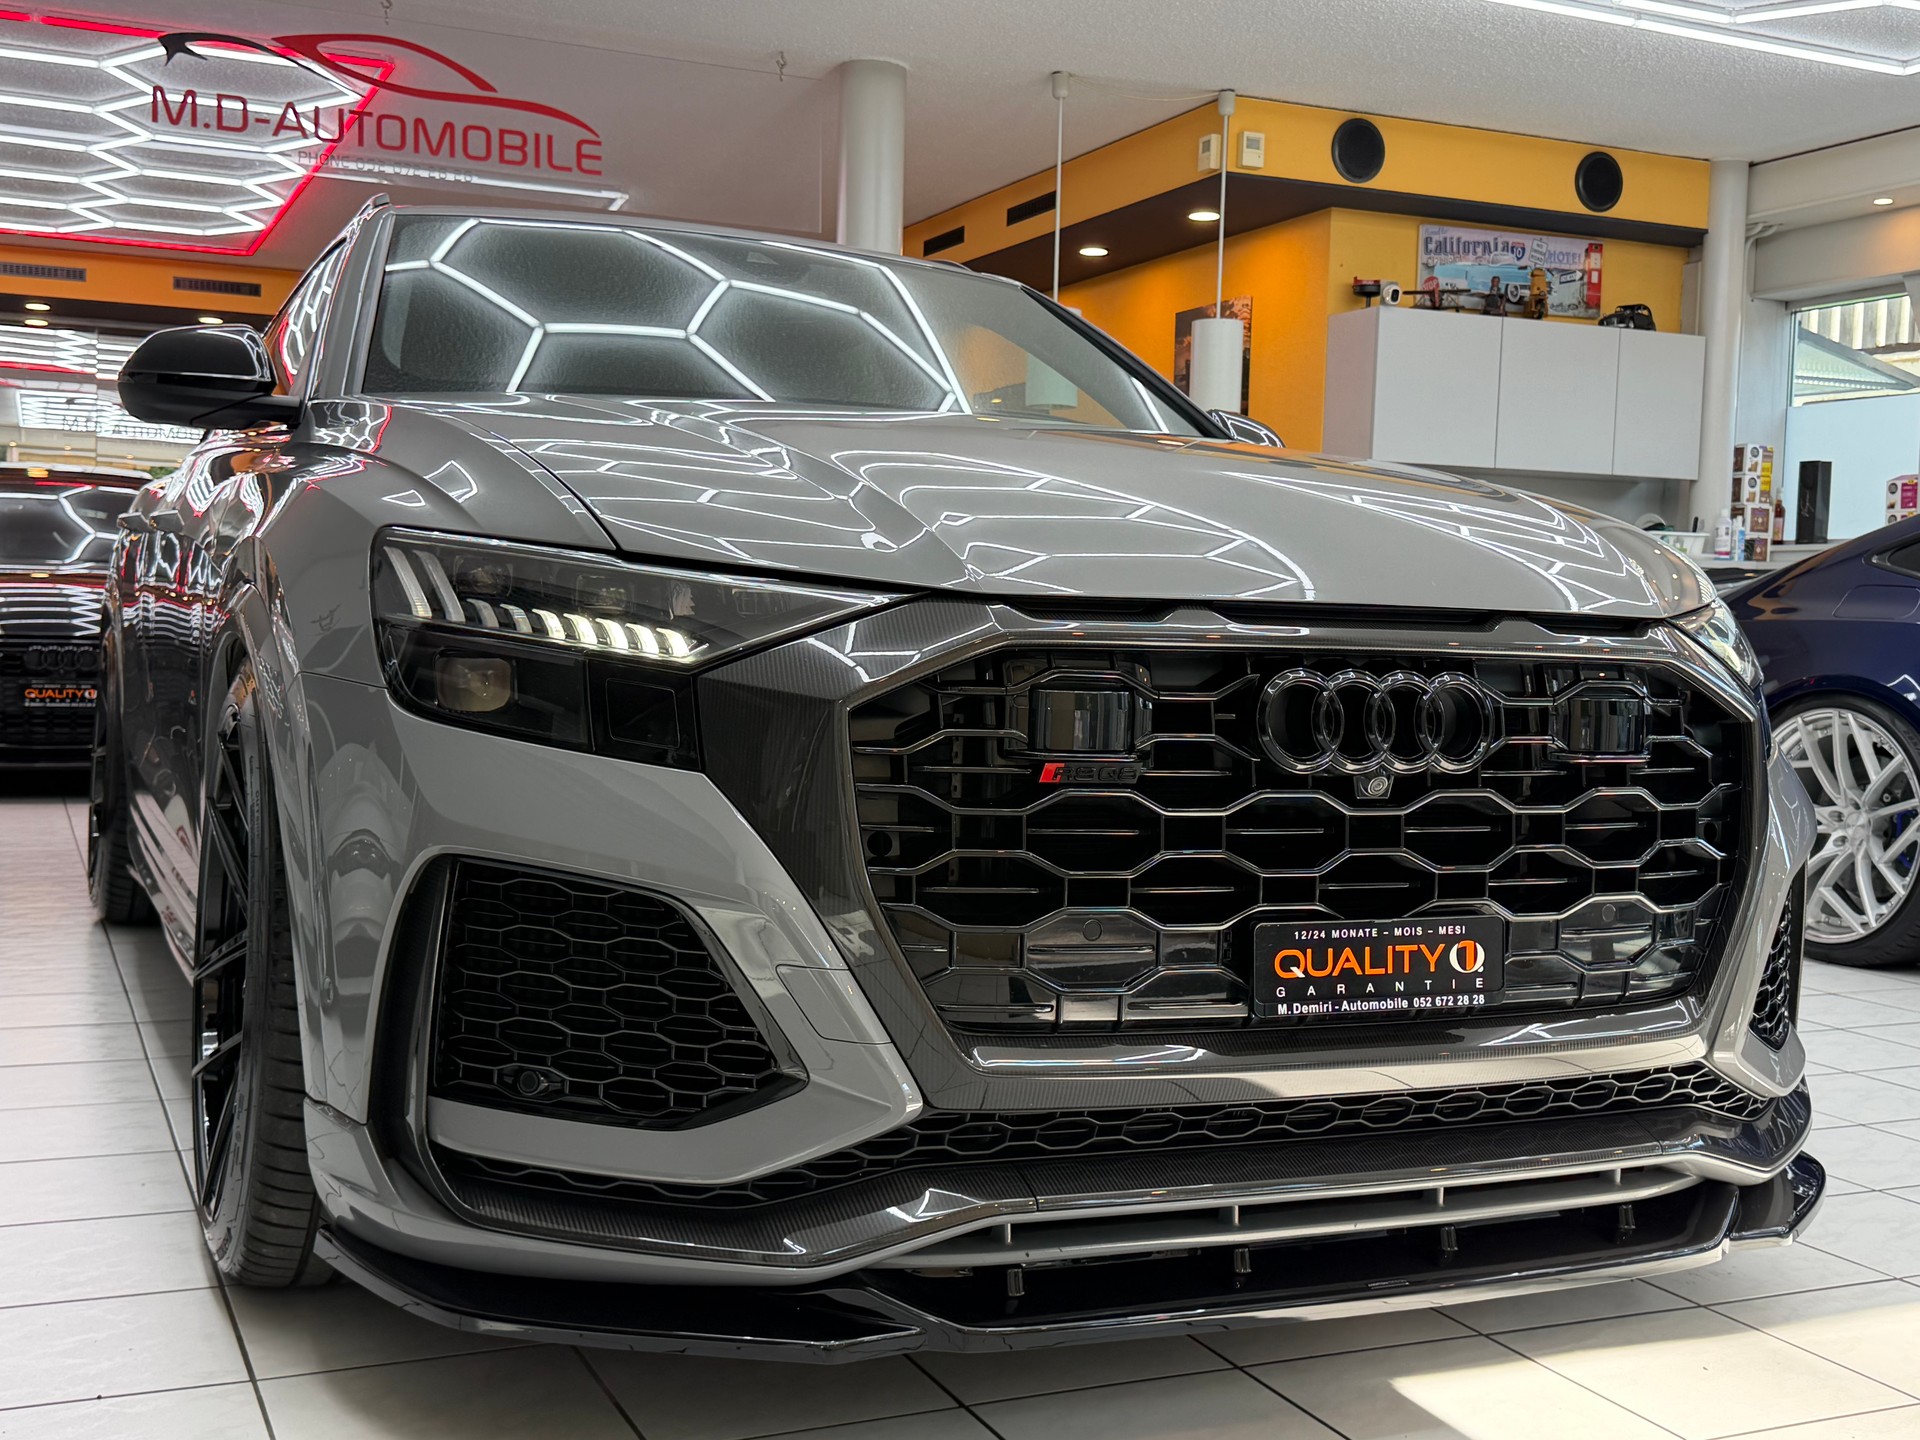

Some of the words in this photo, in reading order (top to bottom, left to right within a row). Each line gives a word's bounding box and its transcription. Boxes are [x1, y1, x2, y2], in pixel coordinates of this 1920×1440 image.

[151, 85, 602, 176] M.D-AUTOMOBILE
[298, 151, 350, 168] PHONE
[1424, 236, 1511, 257] California
[25, 689, 84, 699] QUALITY
[1294, 930, 1326, 940] 12/24
[1331, 928, 1378, 939] MONATE
[1394, 927, 1423, 936] MOIS
[1439, 925, 1466, 935] MESI
[1274, 943, 1446, 979] QUALITY
[1276, 977, 1484, 997] GARANTIE
[1341, 997, 1409, 1012] Automobile
[1413, 996, 1432, 1007] 052
[1435, 995, 1454, 1007] 672
[1457, 995, 1470, 1006] 28
[1473, 994, 1485, 1005] 28
